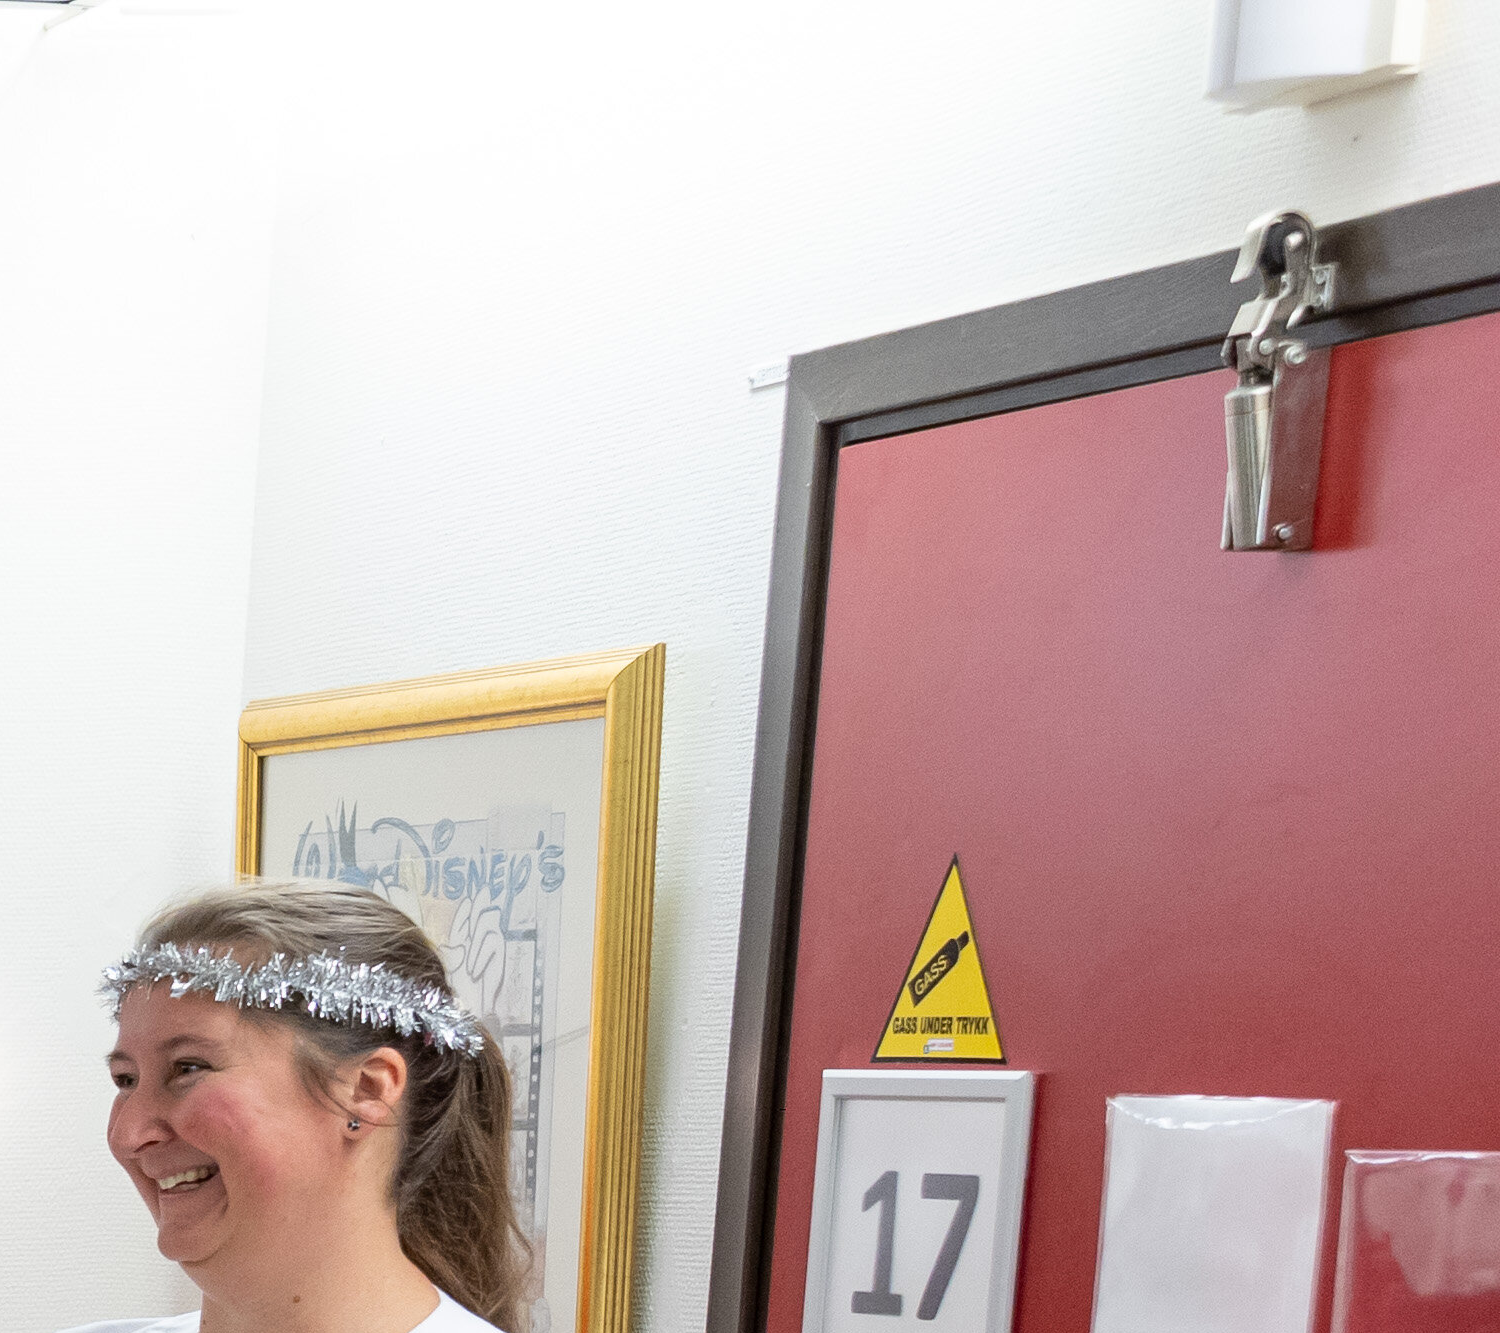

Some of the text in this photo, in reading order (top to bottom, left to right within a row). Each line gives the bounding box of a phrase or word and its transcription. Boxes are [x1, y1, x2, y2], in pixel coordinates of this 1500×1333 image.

[914, 954, 949, 996] GASS
[892, 1017, 989, 1034] GASS UNDER TRYKK
[851, 1170, 980, 1321] 17
